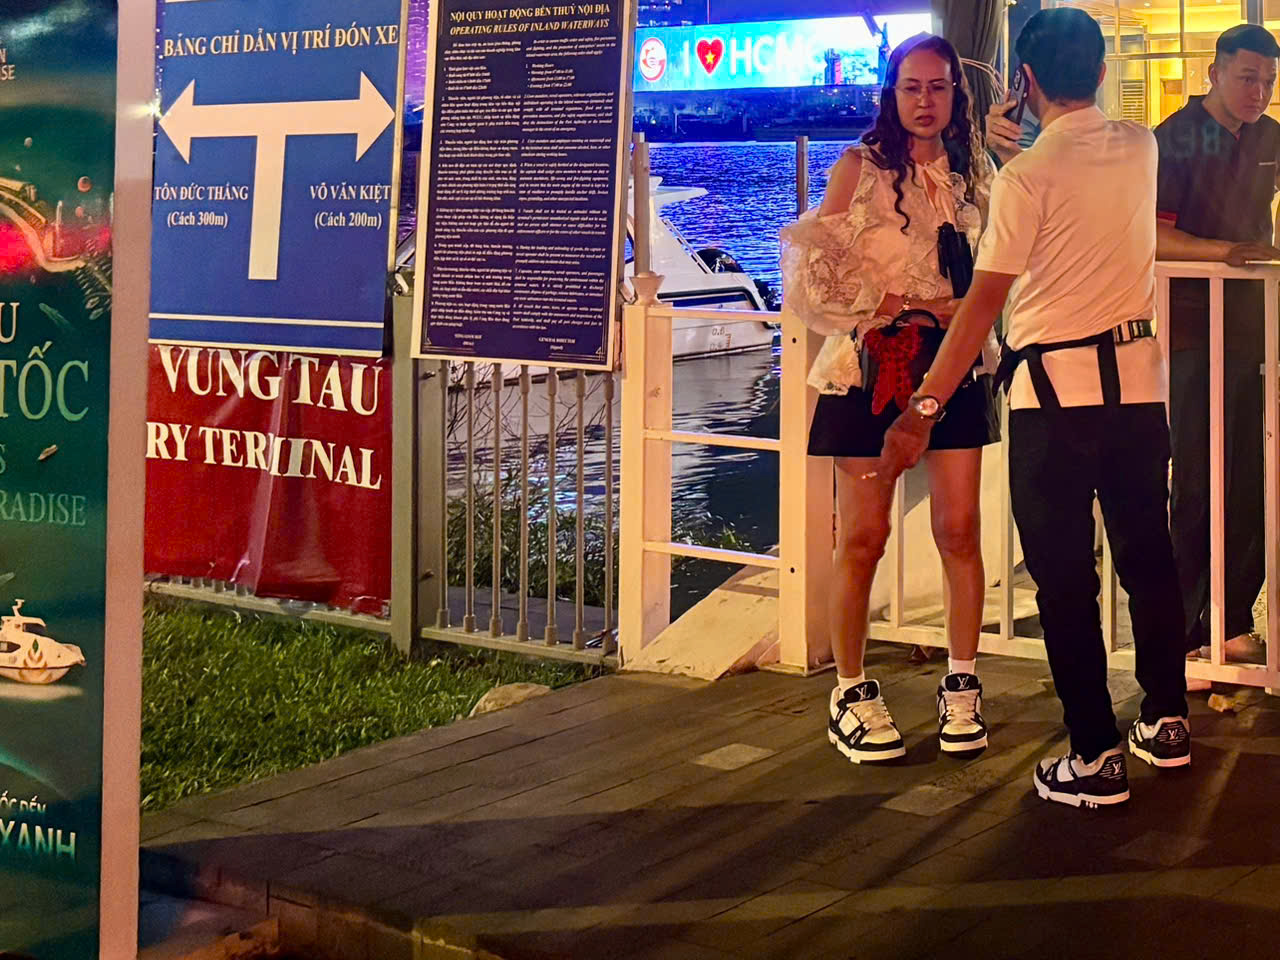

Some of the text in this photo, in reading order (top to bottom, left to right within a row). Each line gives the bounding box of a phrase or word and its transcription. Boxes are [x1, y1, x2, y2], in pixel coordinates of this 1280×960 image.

[466, 10, 484, 21] QUY
[485, 9, 508, 21] HOẠT
[450, 18, 610, 36] OPERATING RULES OF INLAND WATERWAYS
[280, 31, 298, 55] VỊ
[302, 23, 332, 49] TRÍ
[334, 21, 371, 47] ĐÓN
[375, 24, 399, 45] XE
[359, 182, 392, 203] KIỆT
[167, 211, 229, 229] (Cách 300m)
[314, 211, 383, 230] (Cách 200m)
[145, 421, 192, 461] RY
